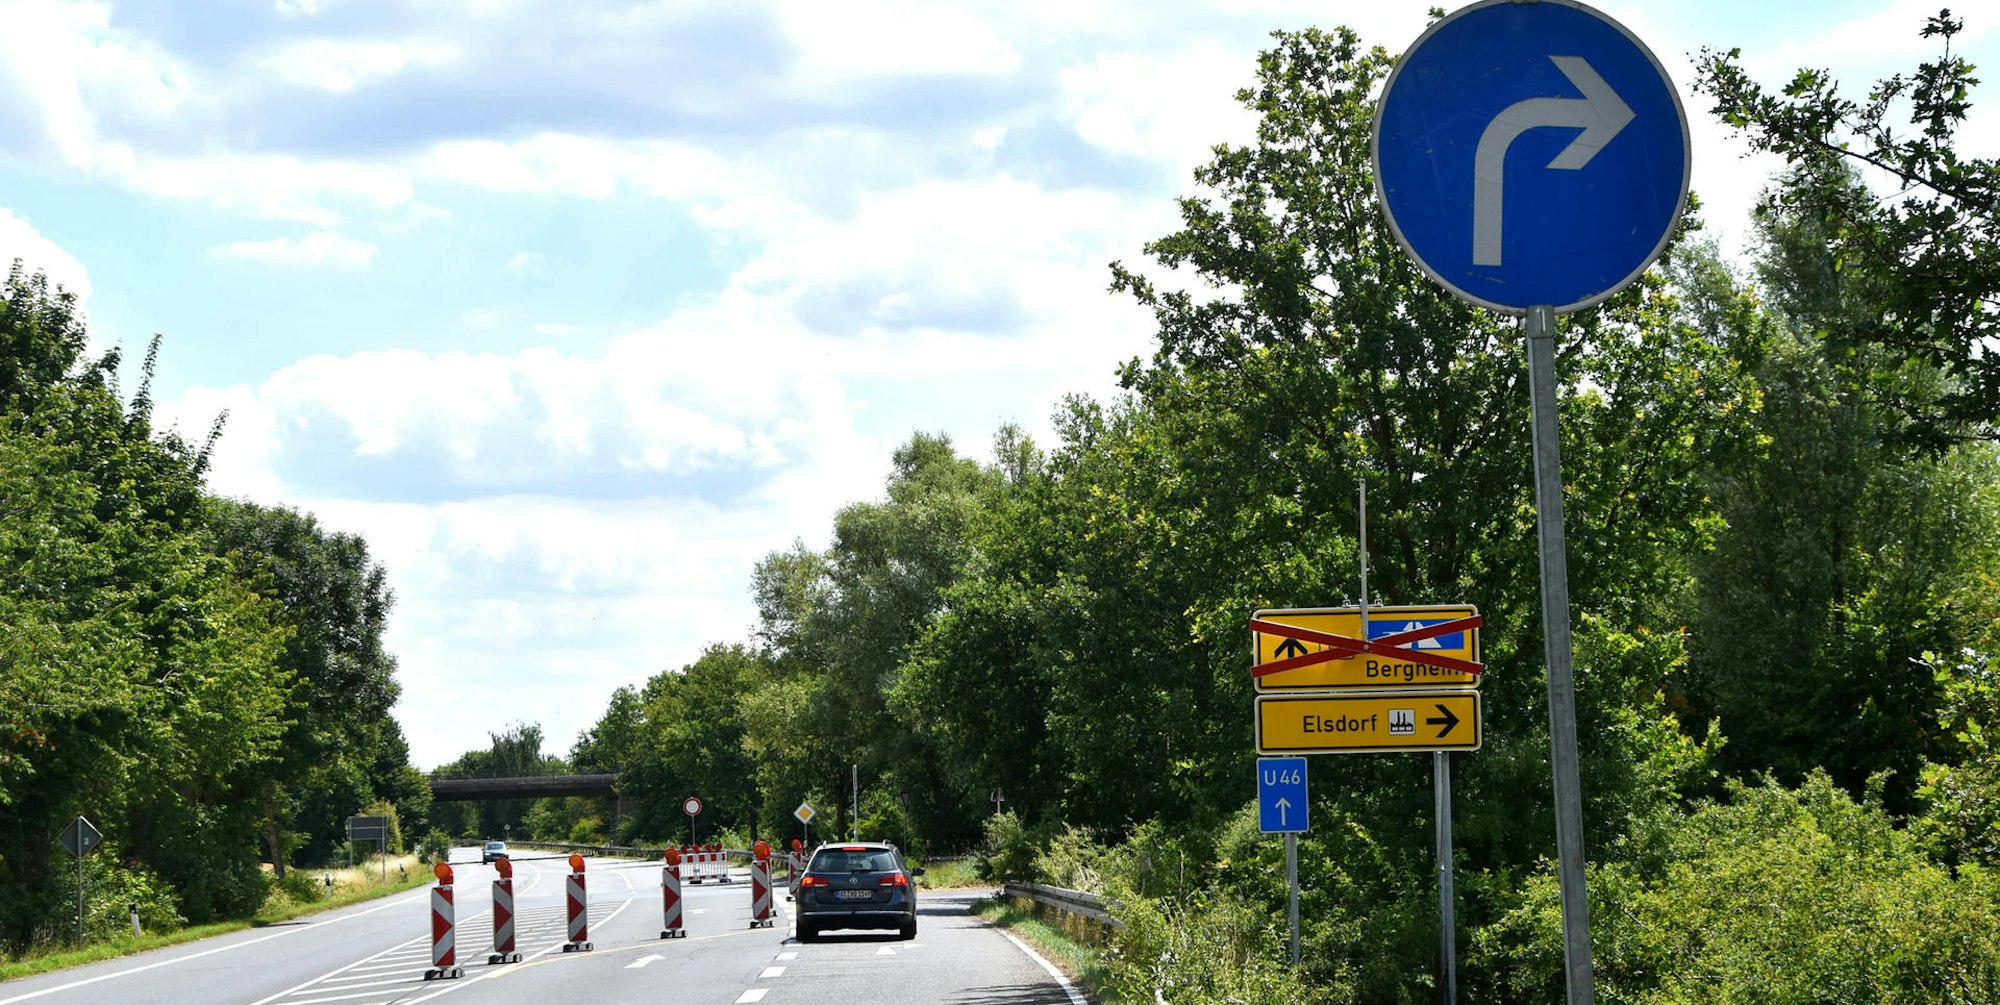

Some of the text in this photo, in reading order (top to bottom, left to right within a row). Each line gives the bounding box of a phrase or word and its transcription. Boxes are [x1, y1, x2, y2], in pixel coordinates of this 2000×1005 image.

[1303, 714, 1378, 733] Elsdorf
[1264, 768, 1301, 786] U 46
